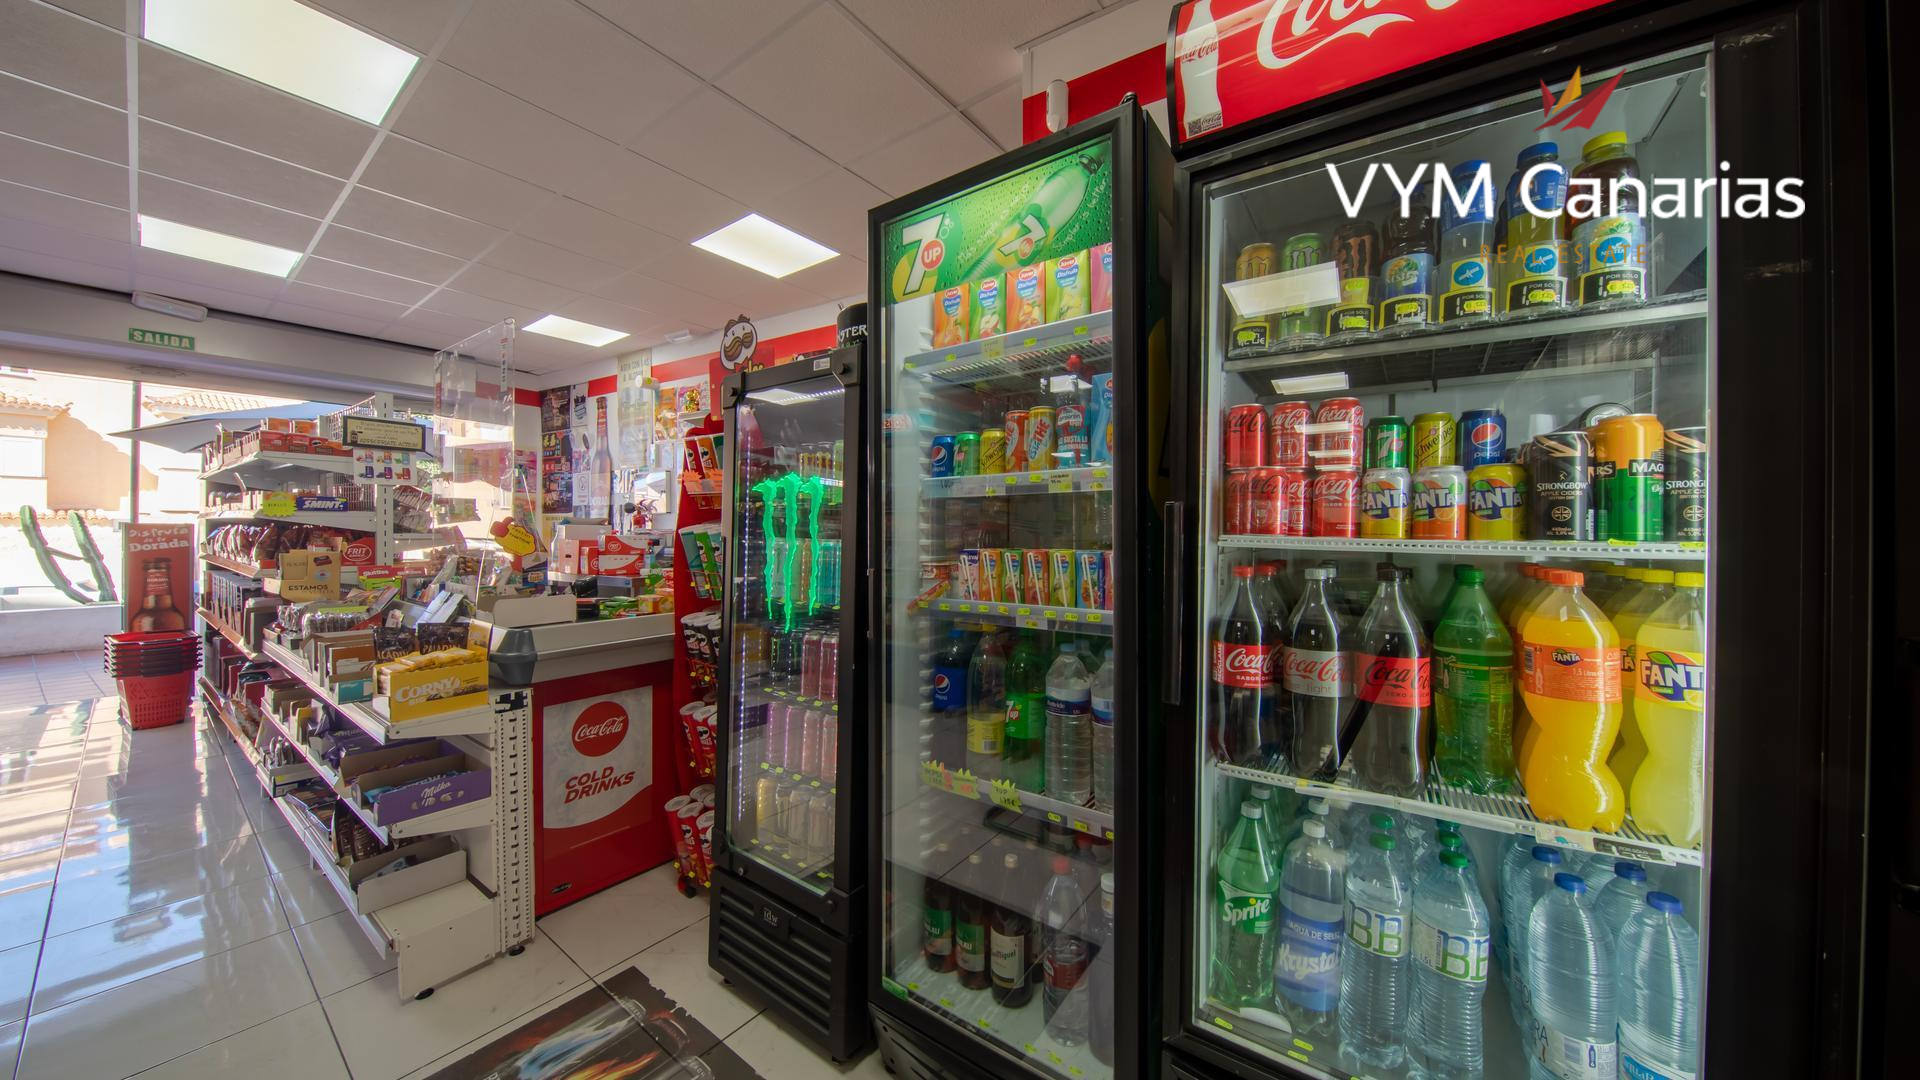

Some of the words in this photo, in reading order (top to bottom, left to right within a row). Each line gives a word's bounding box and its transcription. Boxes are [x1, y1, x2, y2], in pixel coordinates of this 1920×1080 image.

[924, 247, 942, 263] UP
[132, 329, 191, 349] SALIDA
[1536, 482, 1589, 491] STRONGBOW
[1414, 488, 1454, 509] ANTA
[1470, 487, 1523, 510] FANTA
[129, 539, 189, 552] Dorada
[347, 547, 366, 555] FRIT
[1551, 650, 1582, 663] FANTA
[1641, 658, 1704, 688] FANT
[575, 715, 626, 742] Coca-Cola
[563, 770, 637, 804] DRINKS
[564, 766, 614, 790] COLD
[1222, 898, 1271, 927] Sprite
[1312, 930, 1323, 939] DE
